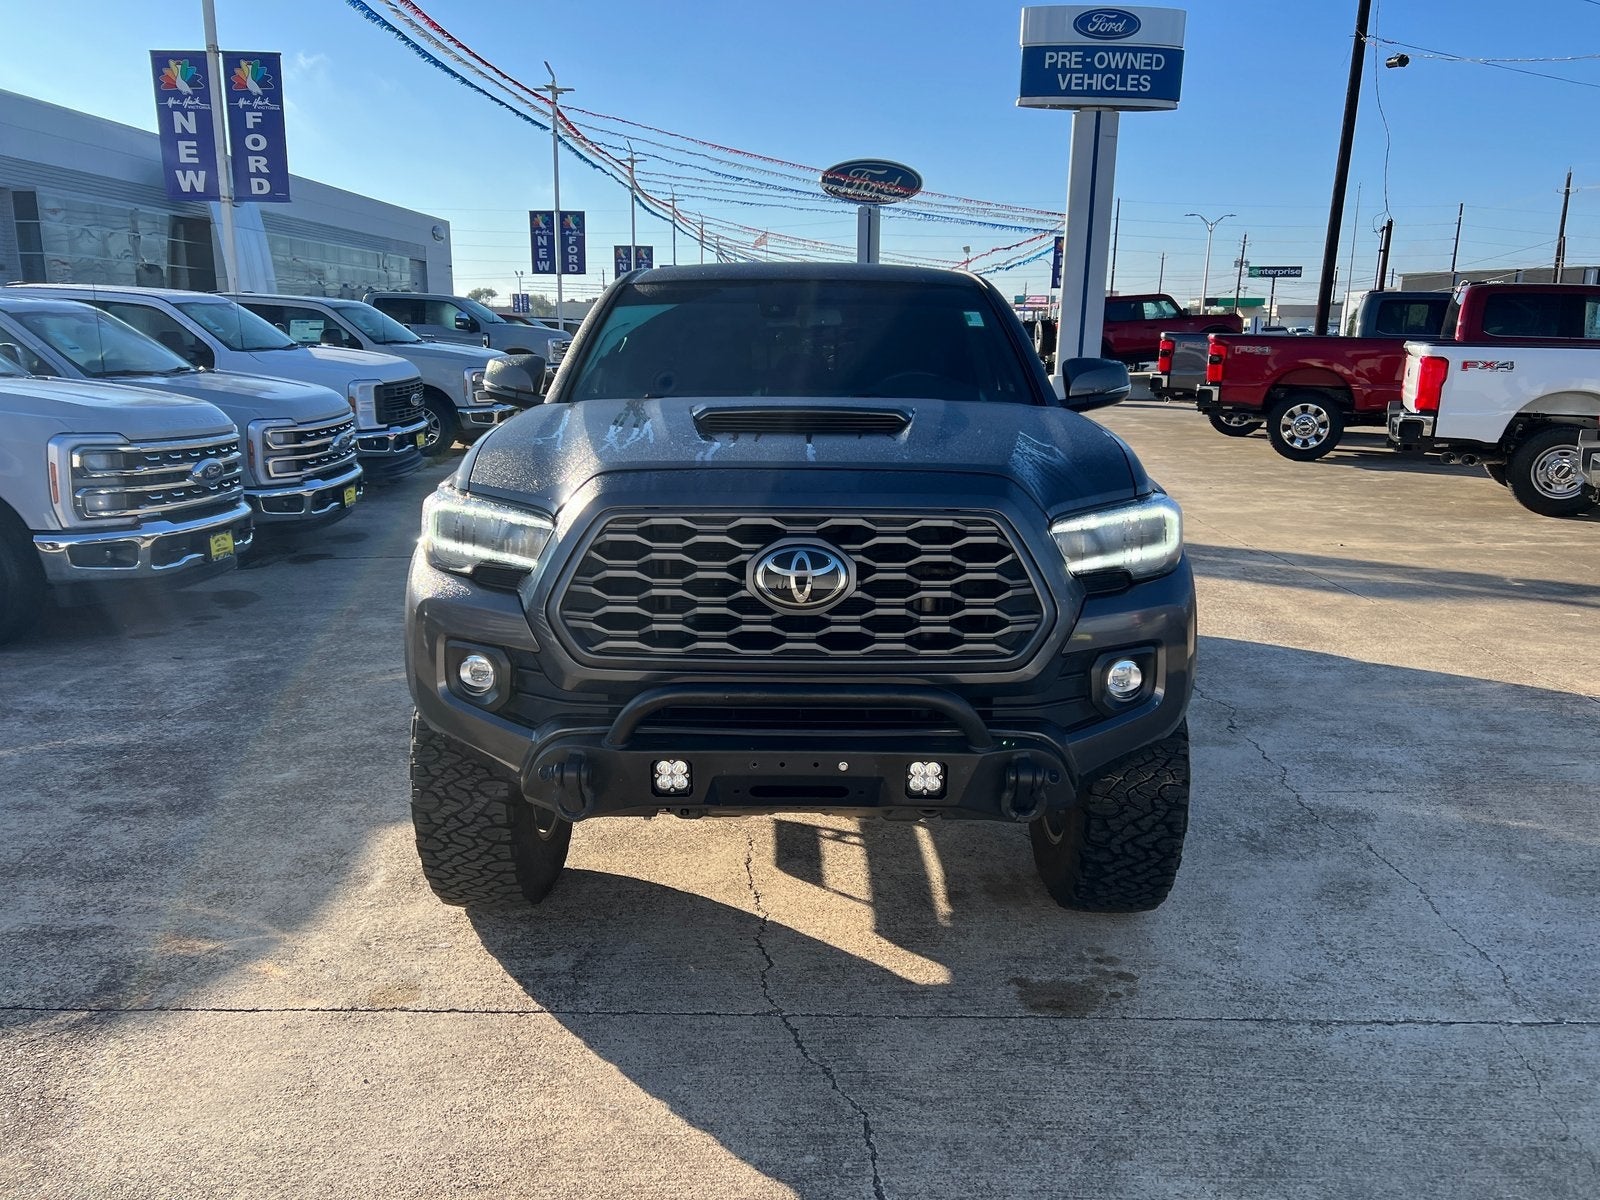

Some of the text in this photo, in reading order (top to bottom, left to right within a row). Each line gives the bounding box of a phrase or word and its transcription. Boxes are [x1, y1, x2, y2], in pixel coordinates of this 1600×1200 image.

[1087, 13, 1127, 32] Ford
[1057, 73, 1151, 92] VEHICLES
[173, 111, 206, 192] NEW
[245, 111, 271, 195] FORD
[843, 167, 902, 195] Ford
[537, 235, 550, 271] NEW
[567, 236, 578, 272] FORD
[1251, 267, 1302, 276] enterprise
[1461, 360, 1515, 371] FX4
